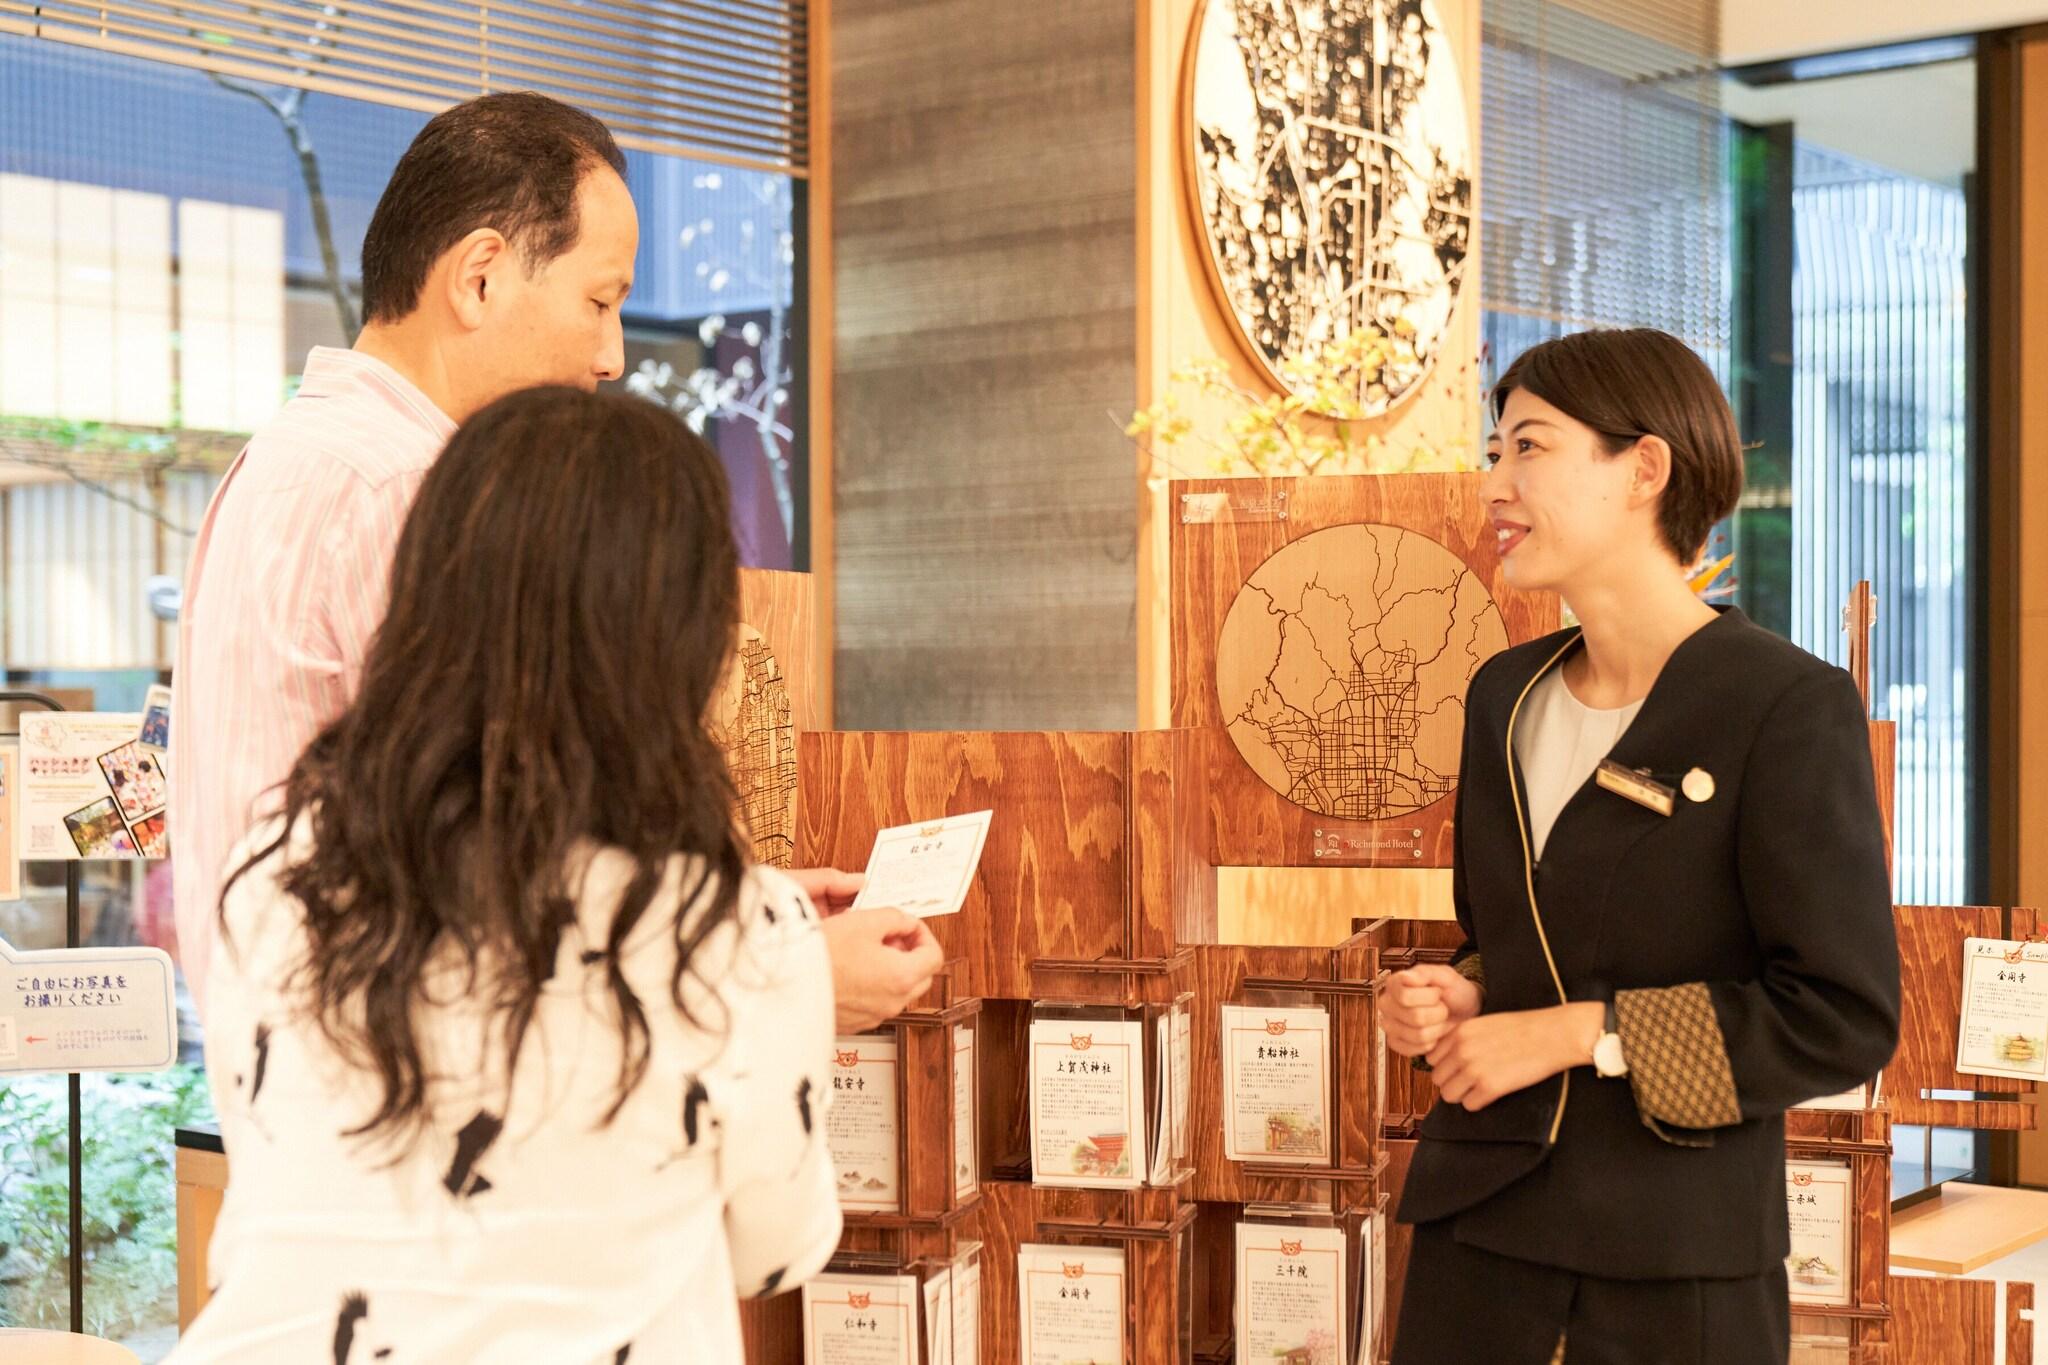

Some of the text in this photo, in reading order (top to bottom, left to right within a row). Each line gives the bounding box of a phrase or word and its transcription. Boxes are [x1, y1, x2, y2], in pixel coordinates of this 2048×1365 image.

[1351, 839, 1414, 849] Richmond Hotel
[17, 975, 128, 990] ご自由にお写真を
[1997, 970, 2026, 983] 金閣寺
[24, 992, 121, 1007] お撮りください
[1257, 1046, 1300, 1060] 貴船神社
[1056, 1060, 1111, 1075] 上賀茂神社
[833, 1076, 864, 1091] 龍安寺
[1276, 1265, 1308, 1278] 三千院
[1058, 1286, 1091, 1300] 金閣寺
[844, 1317, 877, 1332] 仁和寺
